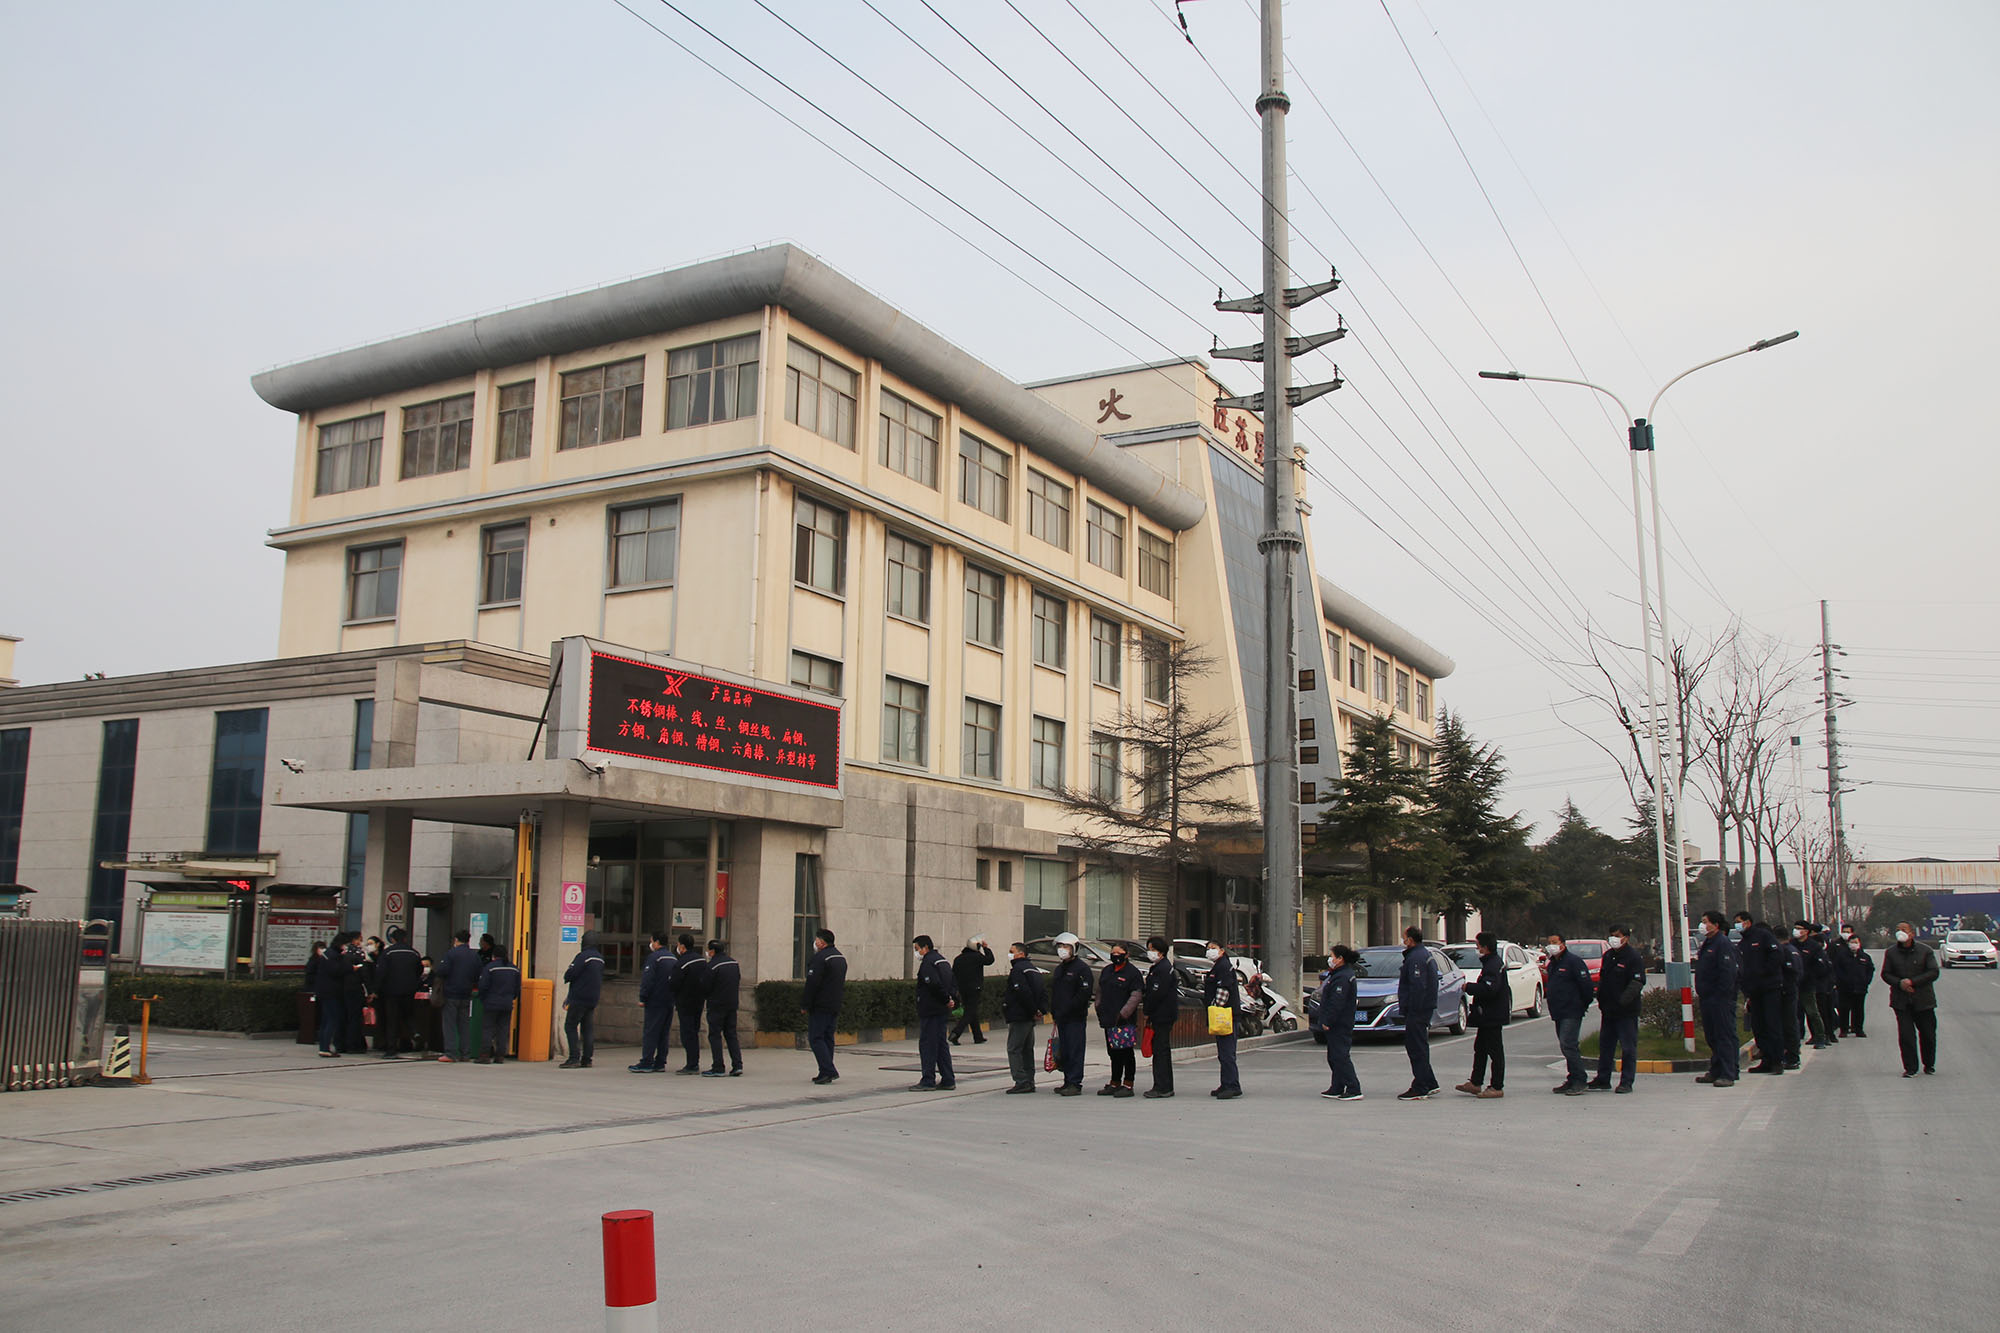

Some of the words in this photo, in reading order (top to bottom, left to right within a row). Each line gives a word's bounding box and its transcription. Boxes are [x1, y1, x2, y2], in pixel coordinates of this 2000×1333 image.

[1097, 388, 1132, 424] 火
[709, 685, 753, 708] 产品品种
